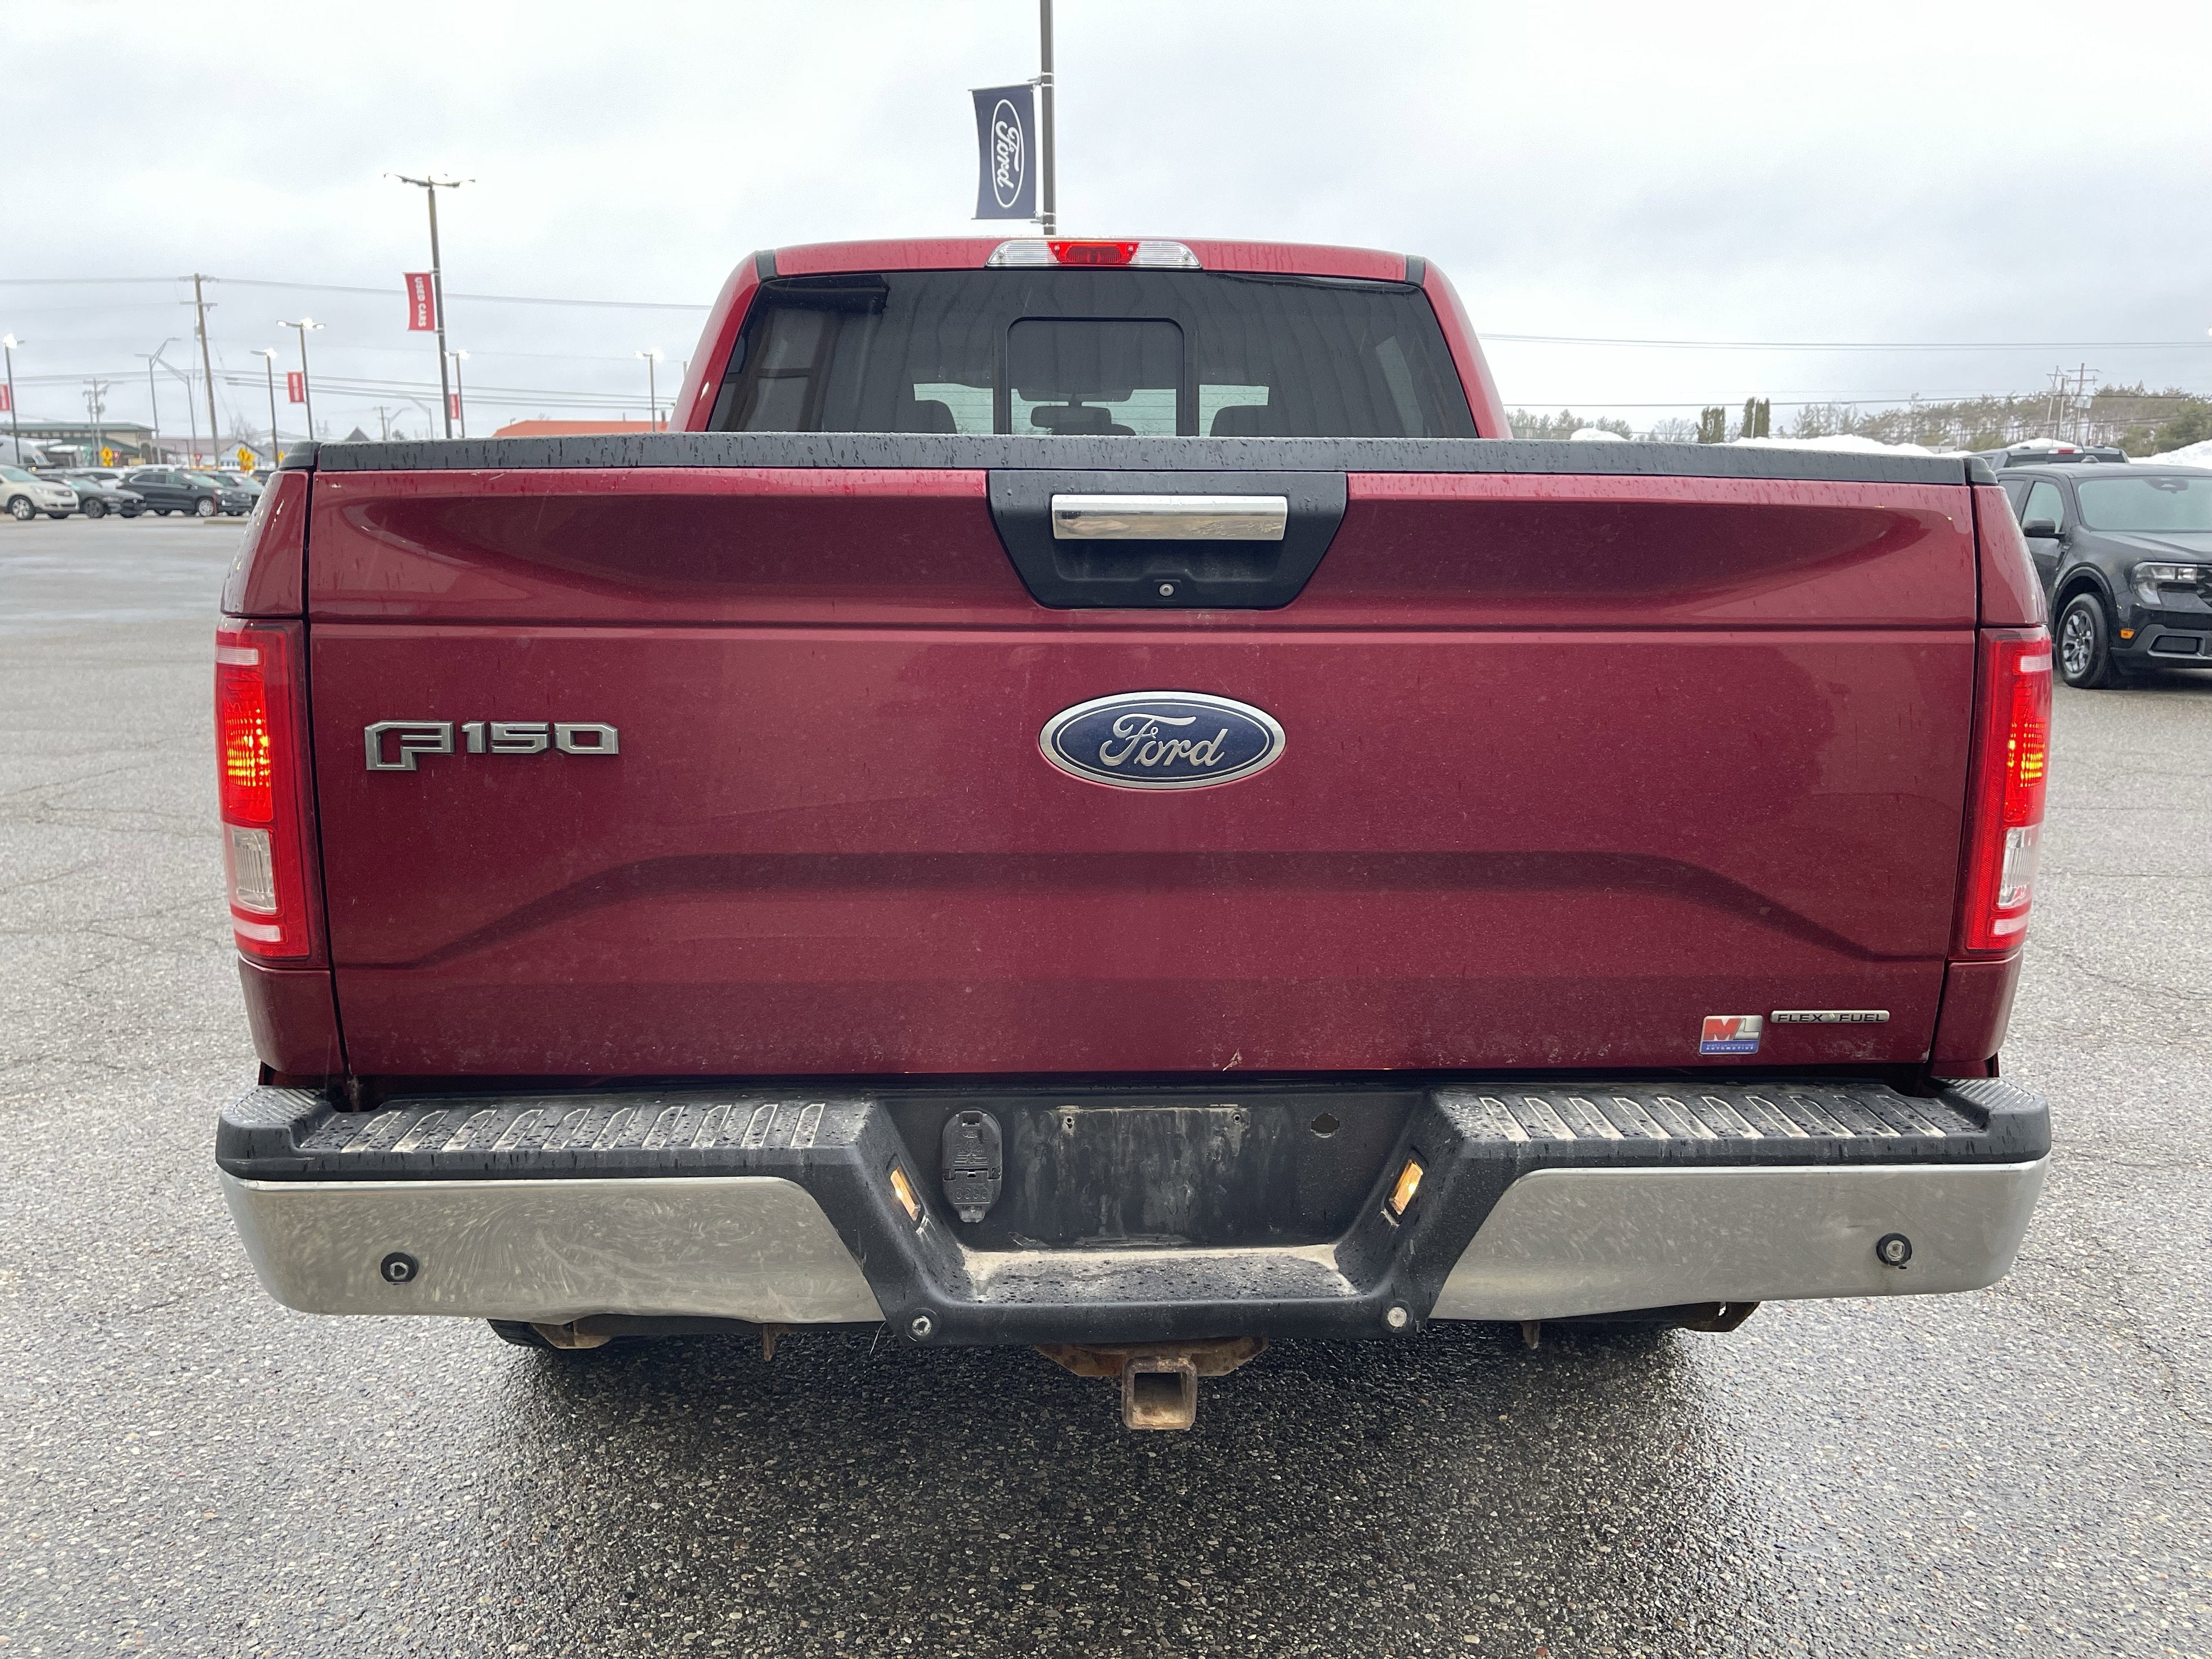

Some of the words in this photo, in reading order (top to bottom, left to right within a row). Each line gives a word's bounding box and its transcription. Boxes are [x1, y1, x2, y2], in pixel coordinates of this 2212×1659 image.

[995, 120, 1020, 188] Ford
[414, 276, 426, 302] USED
[417, 302, 427, 327] CARS
[1098, 713, 1229, 767] Ford
[1777, 1013, 1823, 1023] FLEX
[1838, 1013, 1885, 1022] FUEL
